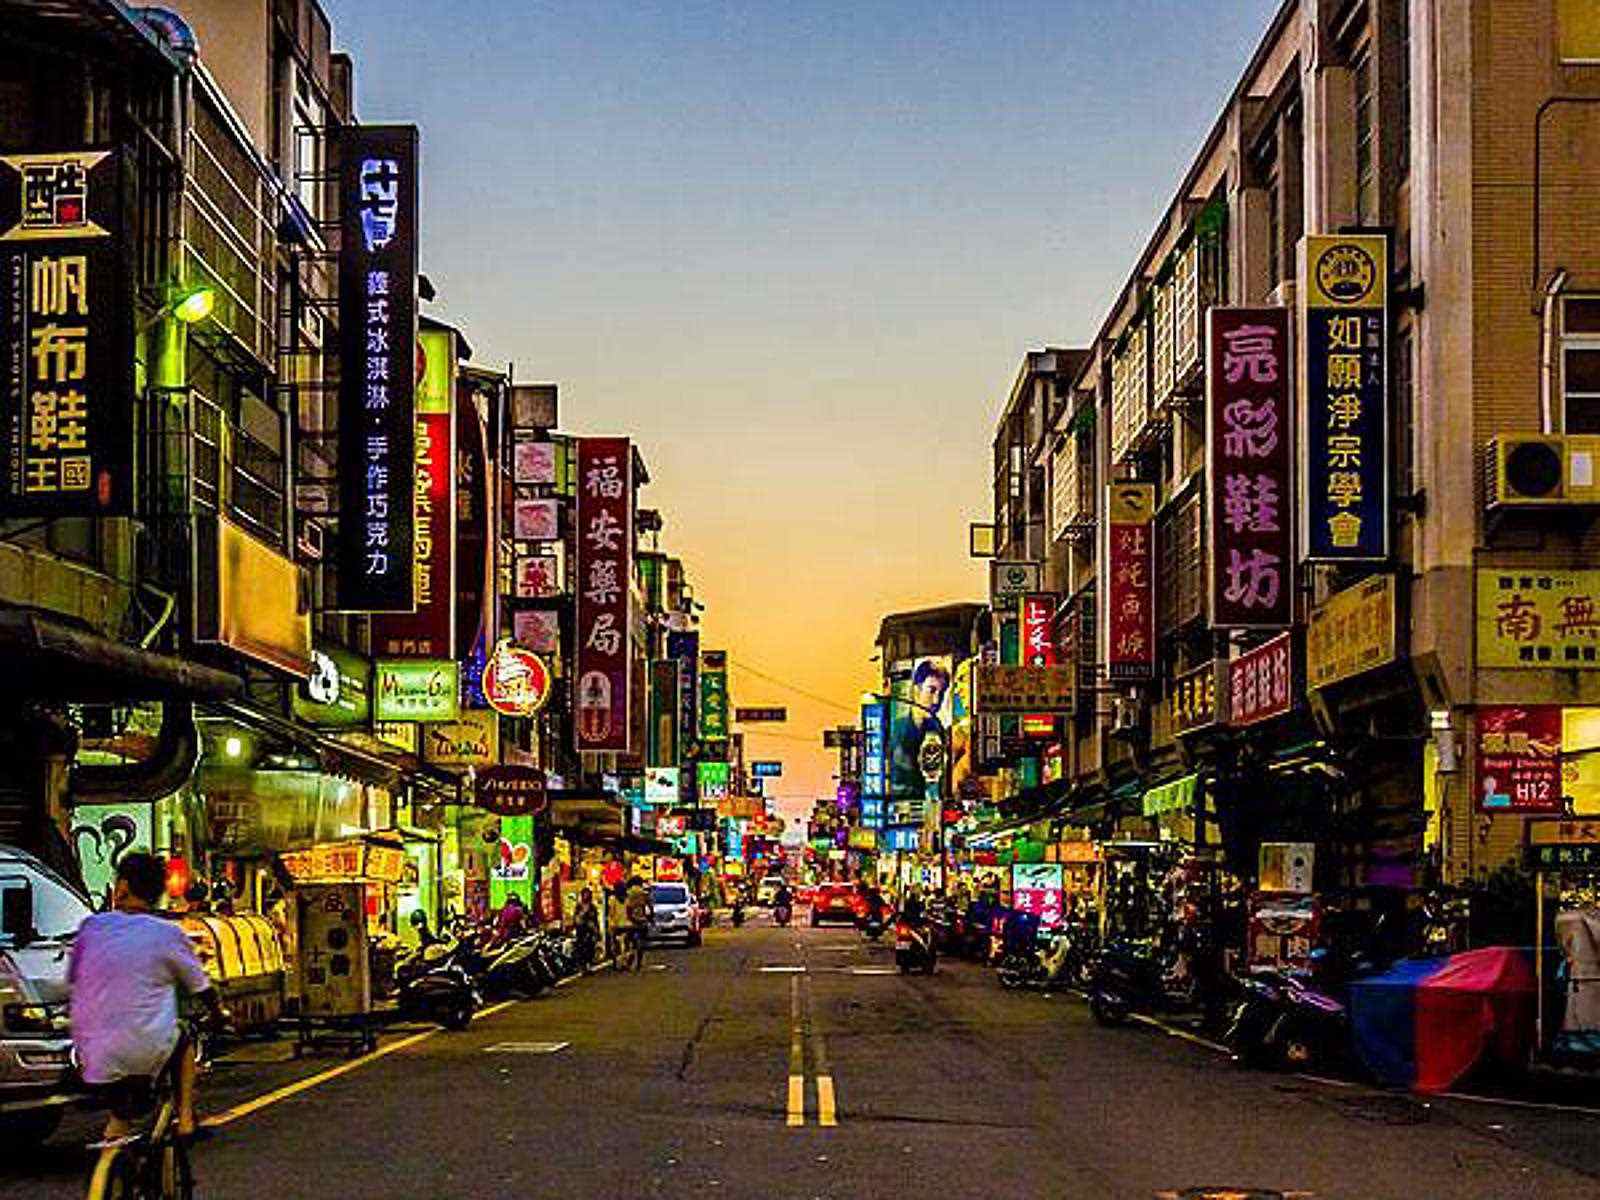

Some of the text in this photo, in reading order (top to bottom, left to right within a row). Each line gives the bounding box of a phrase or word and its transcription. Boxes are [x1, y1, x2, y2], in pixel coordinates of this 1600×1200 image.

[1222, 324, 1281, 609] 亮彩鞋坊
[1326, 315, 1363, 548] 如願淨宗學會
[584, 457, 624, 657] 福安藥局
